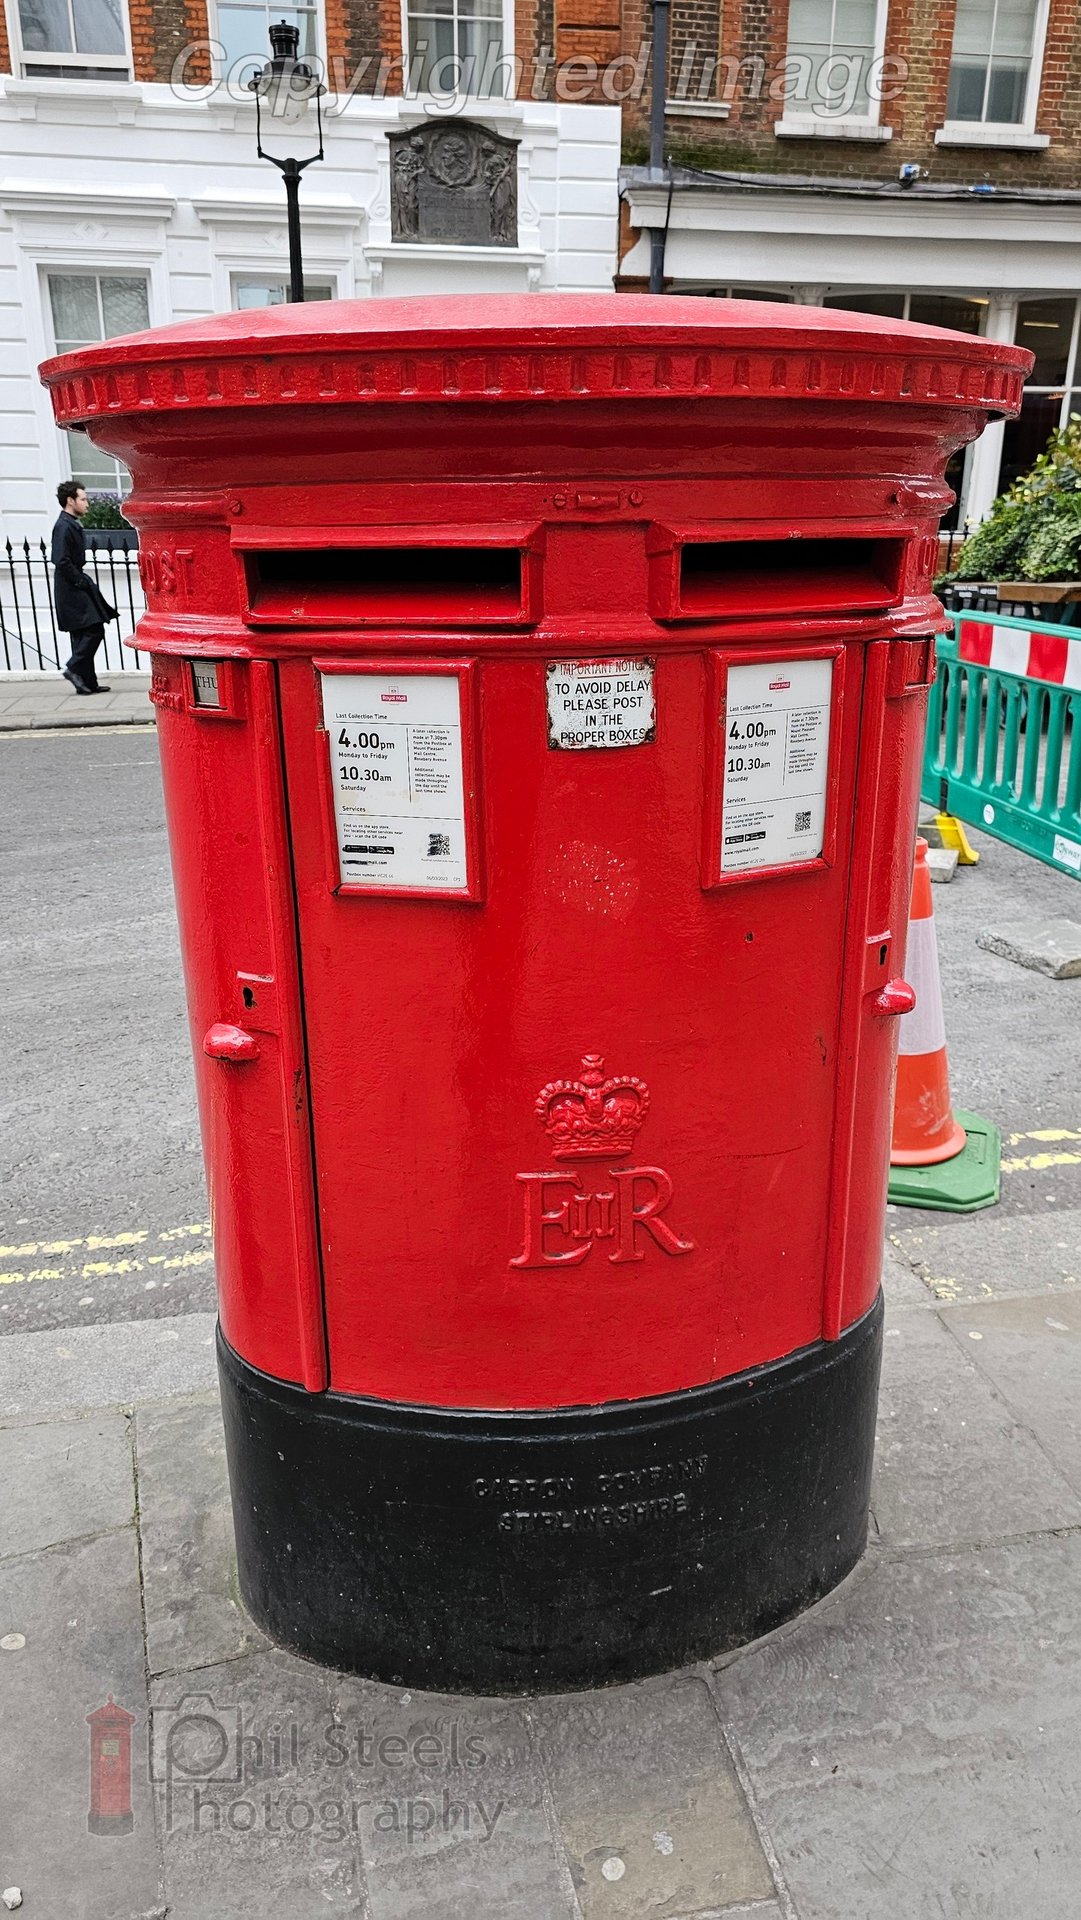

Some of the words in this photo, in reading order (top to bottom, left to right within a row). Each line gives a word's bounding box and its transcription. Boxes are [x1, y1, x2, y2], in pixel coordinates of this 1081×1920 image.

[560, 662, 613, 676] IMPORTANT
[555, 683, 570, 695] TO
[575, 681, 611, 694] AVOID
[617, 680, 651, 693] DELAY
[564, 698, 608, 711] PLEASE
[614, 697, 643, 709] POST
[740, 703, 761, 711] Collection
[585, 715, 597, 726] IN
[602, 714, 623, 726] THE
[561, 731, 605, 743] PROPER
[609, 728, 646, 741] BOXES
[729, 721, 776, 740] 4.00pm
[338, 728, 395, 750] 4.00pm
[727, 757, 771, 773] 10.30am
[340, 766, 392, 782] 10.30am
[727, 775, 749, 783] Saturday
[341, 784, 367, 792] Saturday
[597, 1454, 709, 1497] COMPANY
